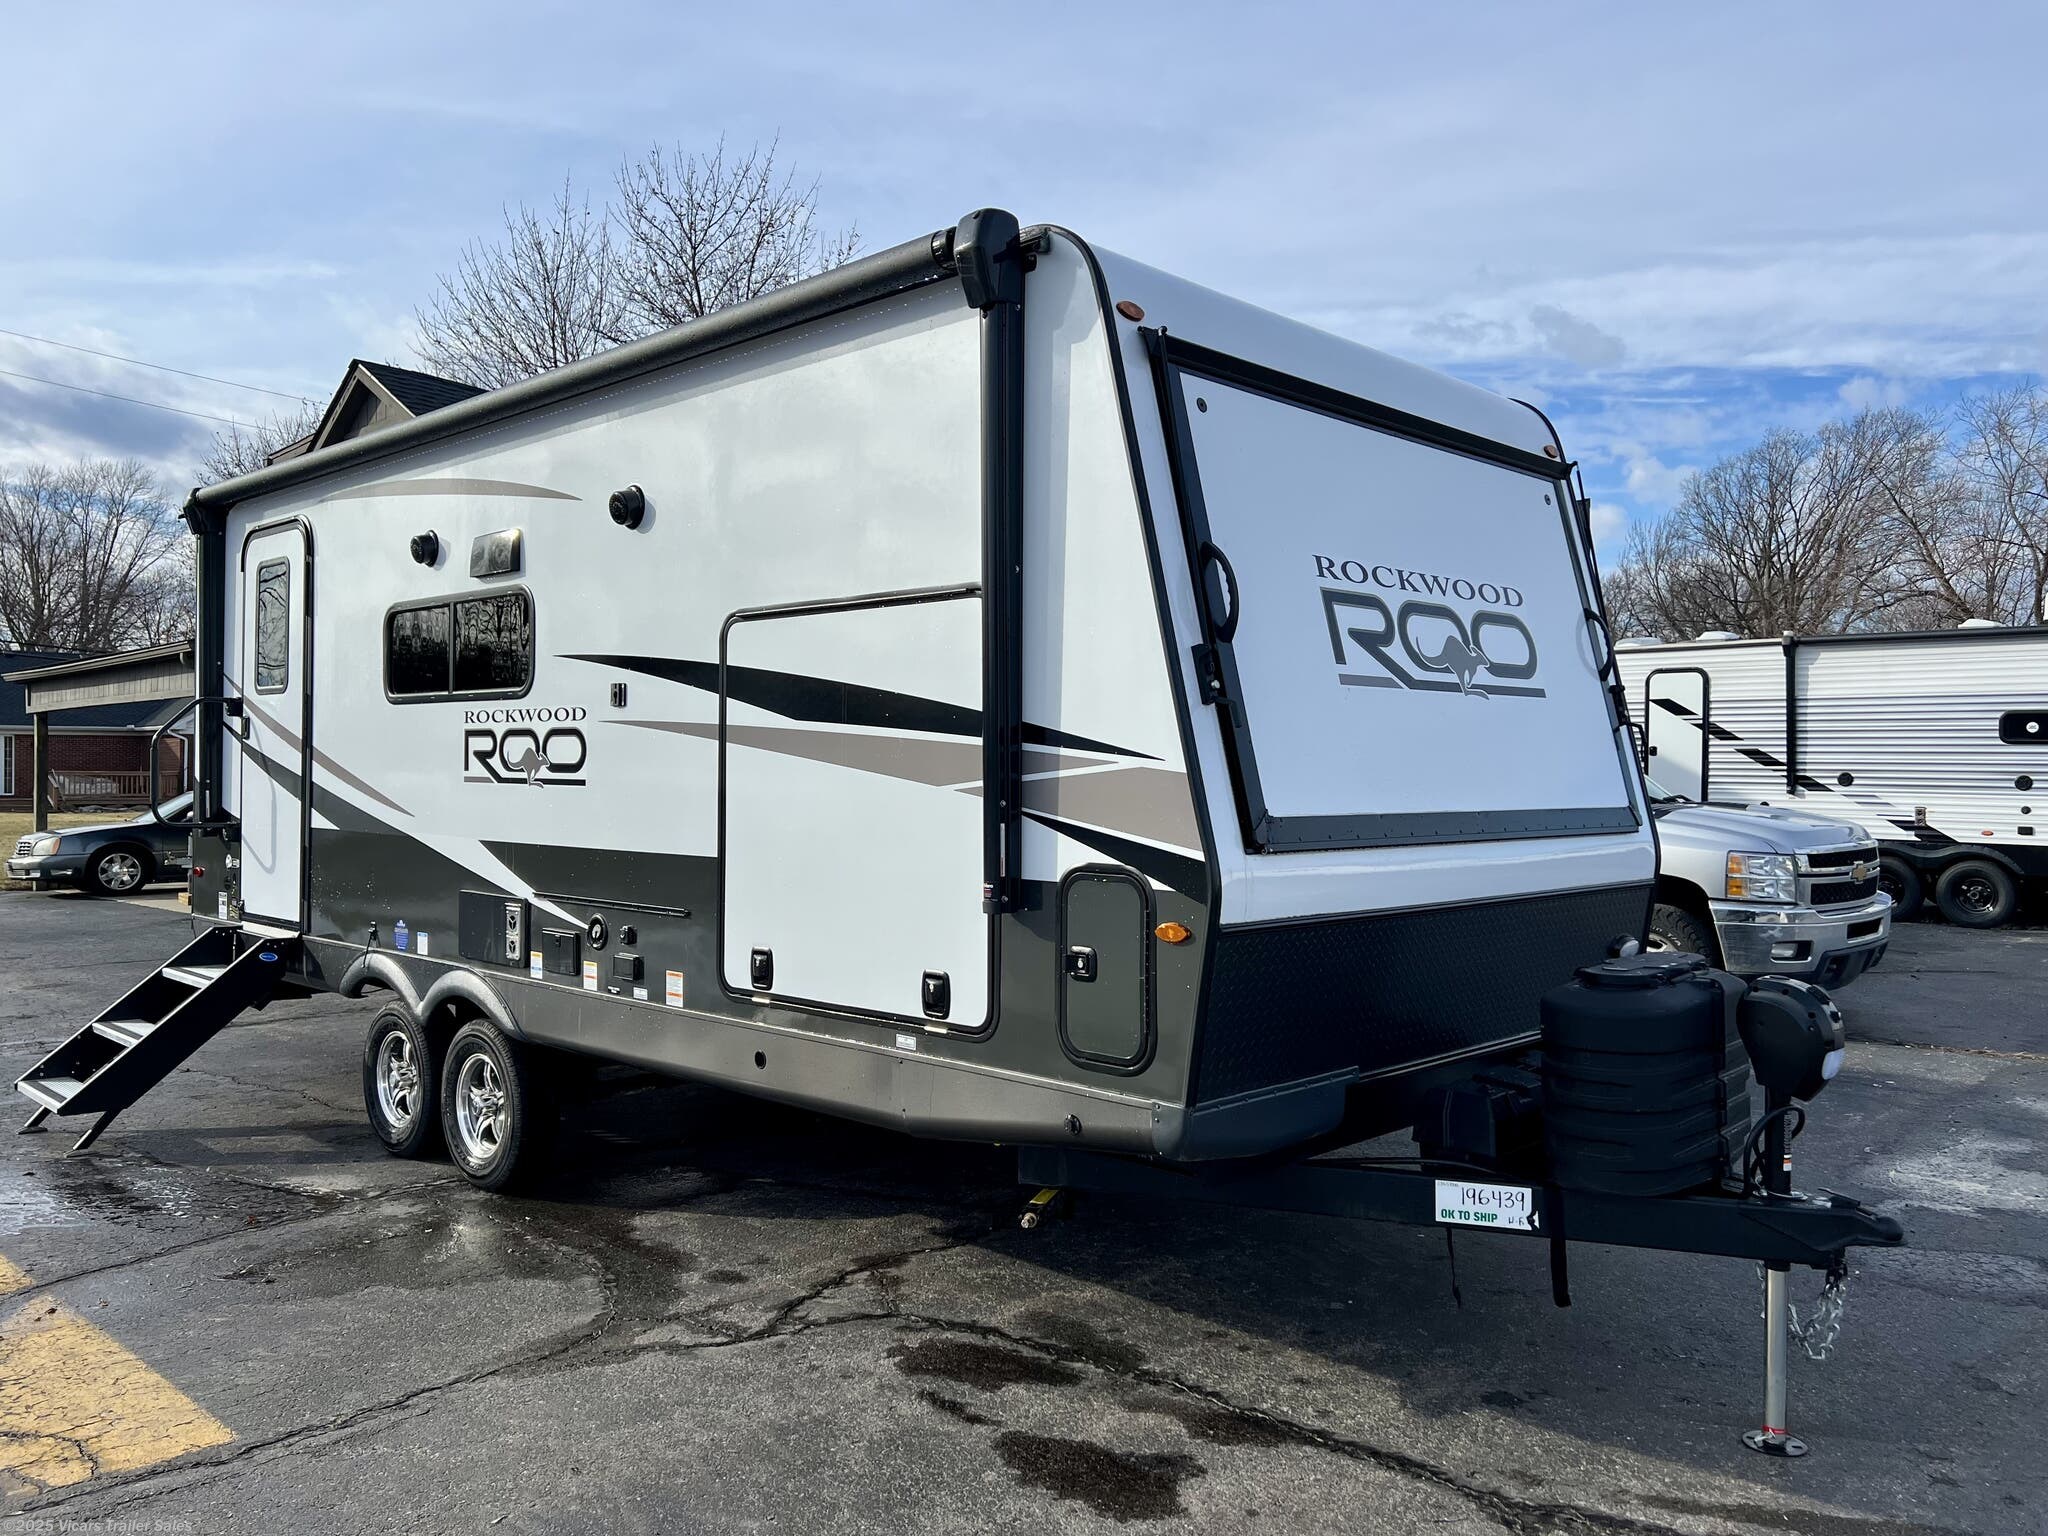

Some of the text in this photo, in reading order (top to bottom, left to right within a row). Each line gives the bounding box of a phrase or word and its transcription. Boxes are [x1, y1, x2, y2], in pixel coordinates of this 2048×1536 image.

[1312, 555, 1524, 607] ROCKWOOD
[1320, 586, 1547, 697] ROO
[464, 707, 587, 724] ROCKWOOD
[464, 727, 587, 786] ROO
[1440, 1208, 1498, 1223] OK TO SHIP
[1461, 1186, 1525, 1212] 196439
